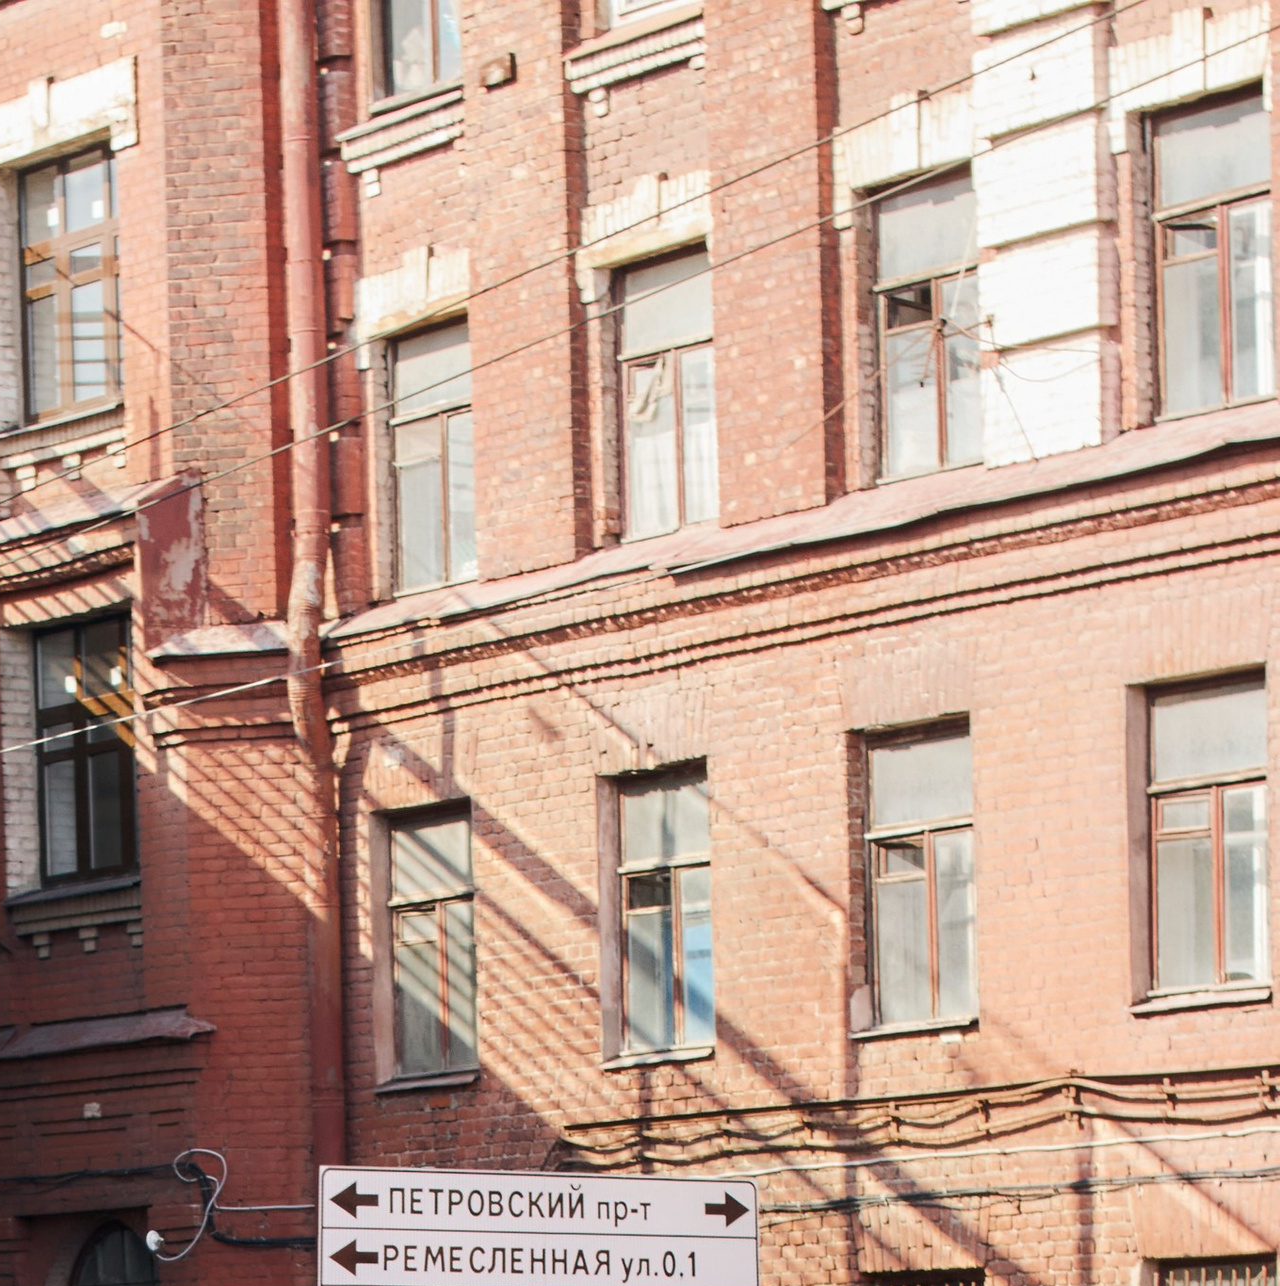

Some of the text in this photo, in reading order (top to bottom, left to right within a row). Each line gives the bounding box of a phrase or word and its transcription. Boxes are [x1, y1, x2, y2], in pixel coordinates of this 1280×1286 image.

[389, 1184, 651, 1228] ПЕТРОВСКИЙ пр-т
[383, 1244, 611, 1276] РЕМЕСЛЕННАЯ
